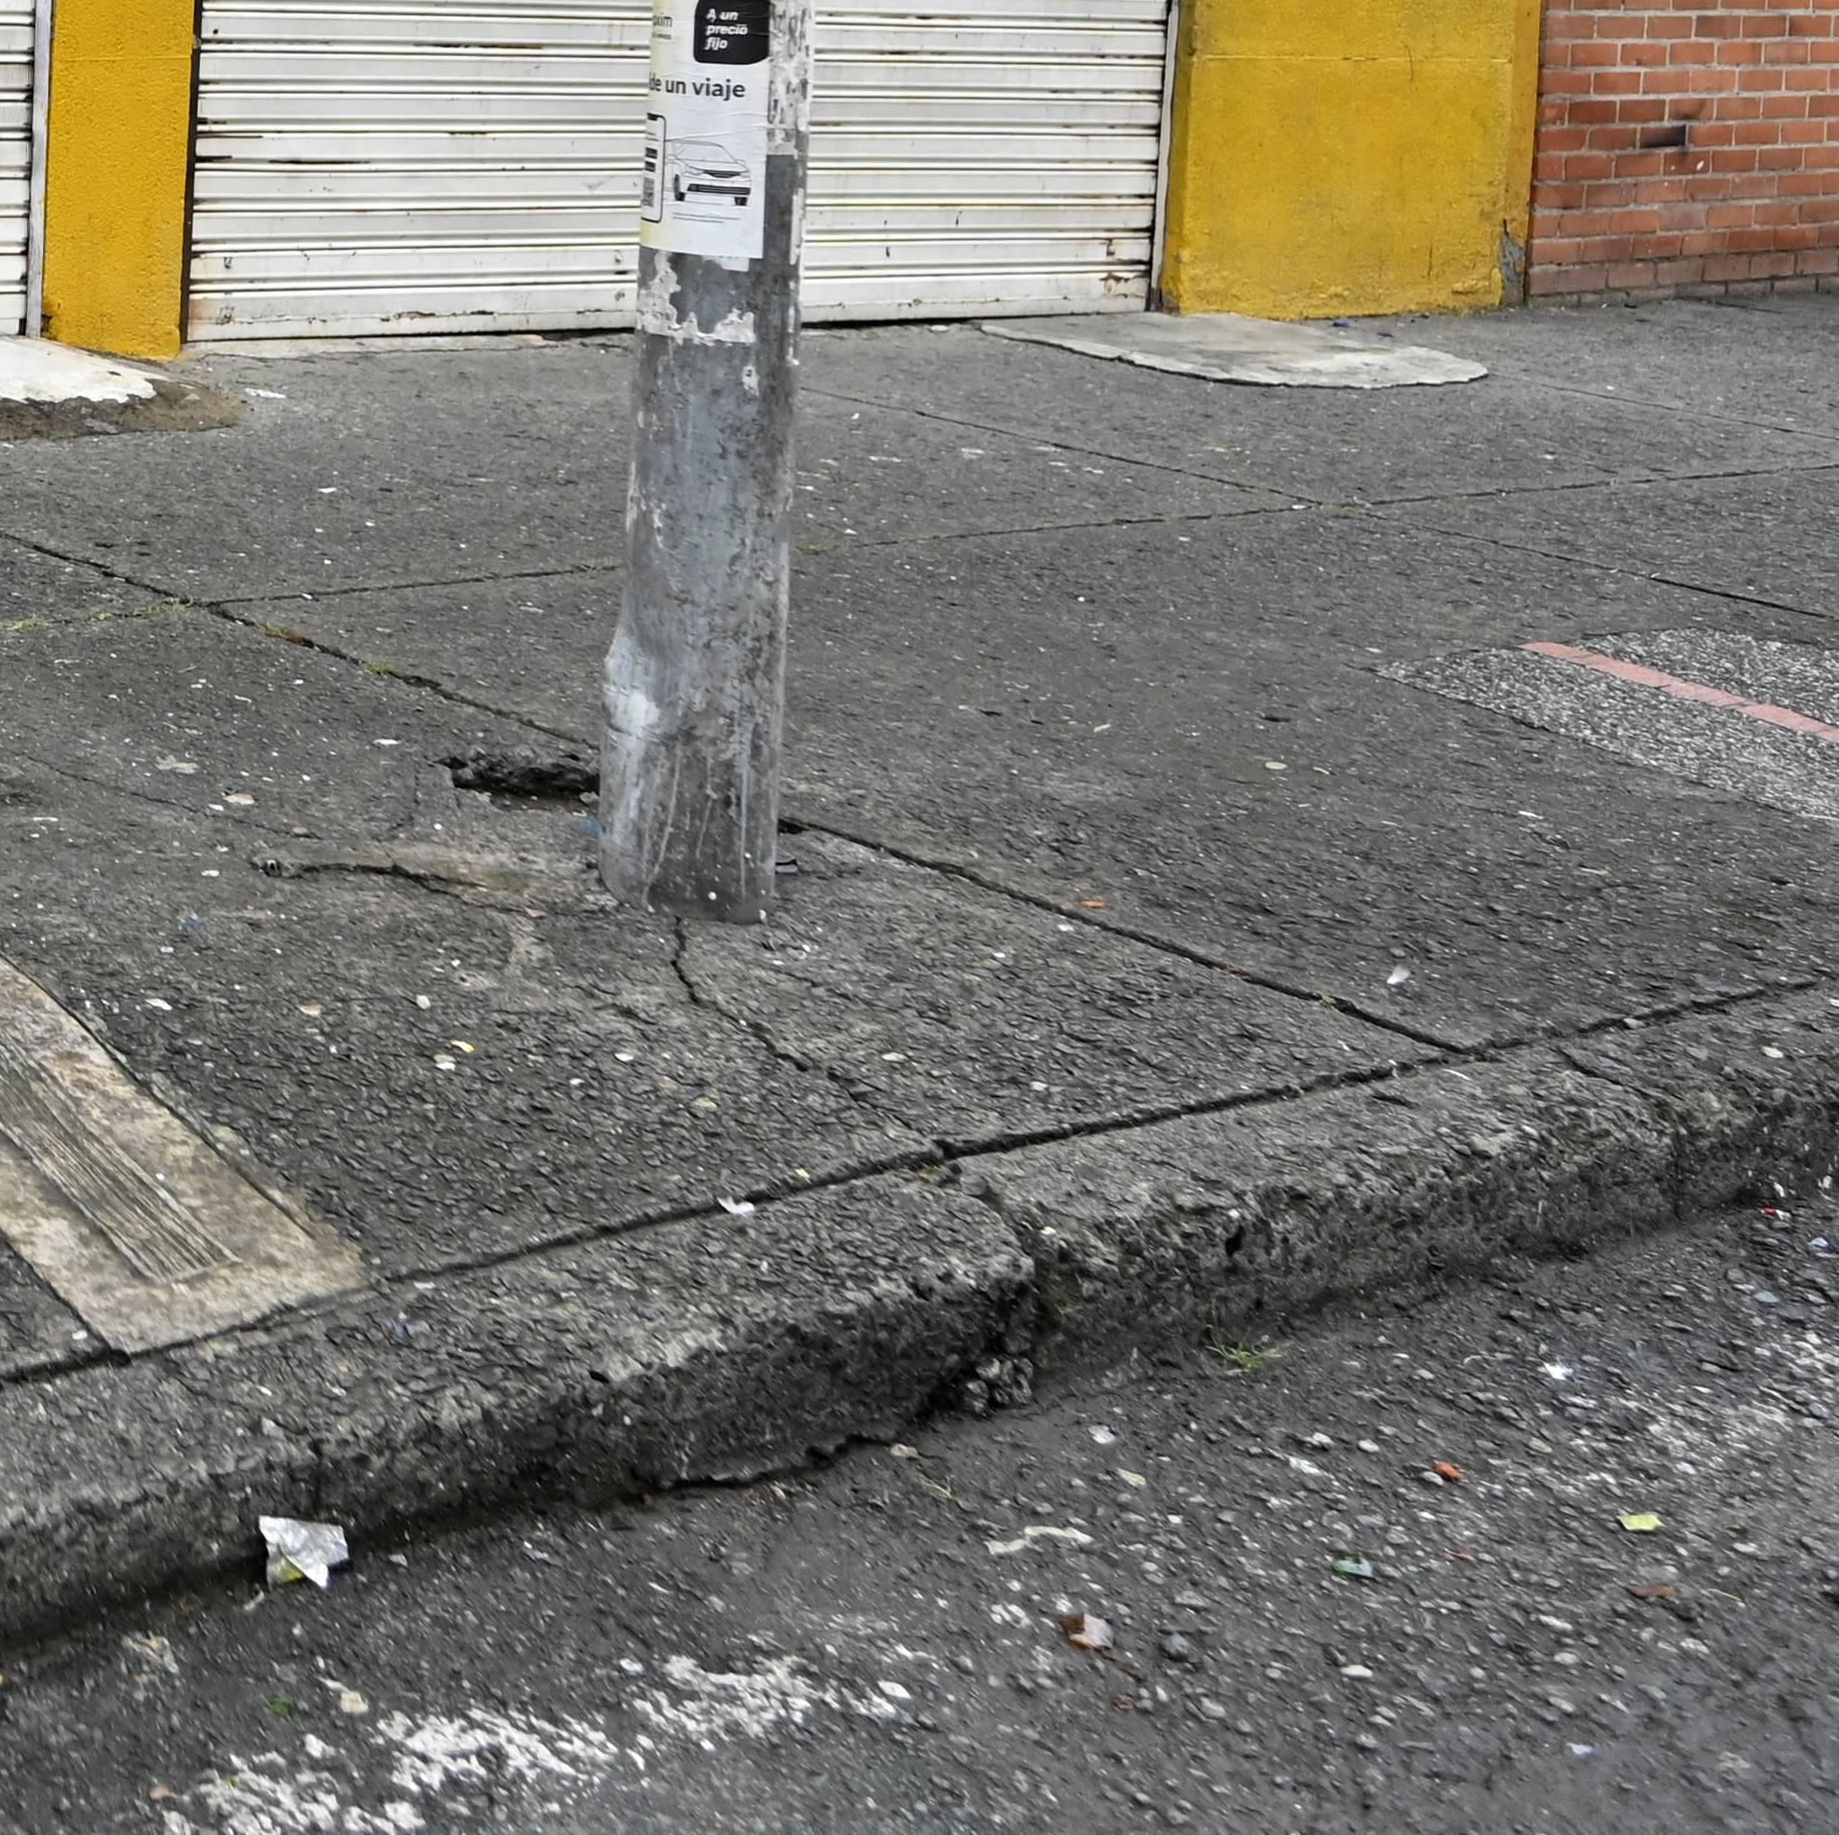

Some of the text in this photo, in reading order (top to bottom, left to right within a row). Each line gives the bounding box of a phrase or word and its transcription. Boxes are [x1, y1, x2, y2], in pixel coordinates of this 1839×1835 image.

[706, 8, 739, 22] A un
[704, 23, 749, 36] precio
[703, 37, 729, 51] fijo
[665, 80, 687, 95] un
[692, 77, 747, 102] viaje
